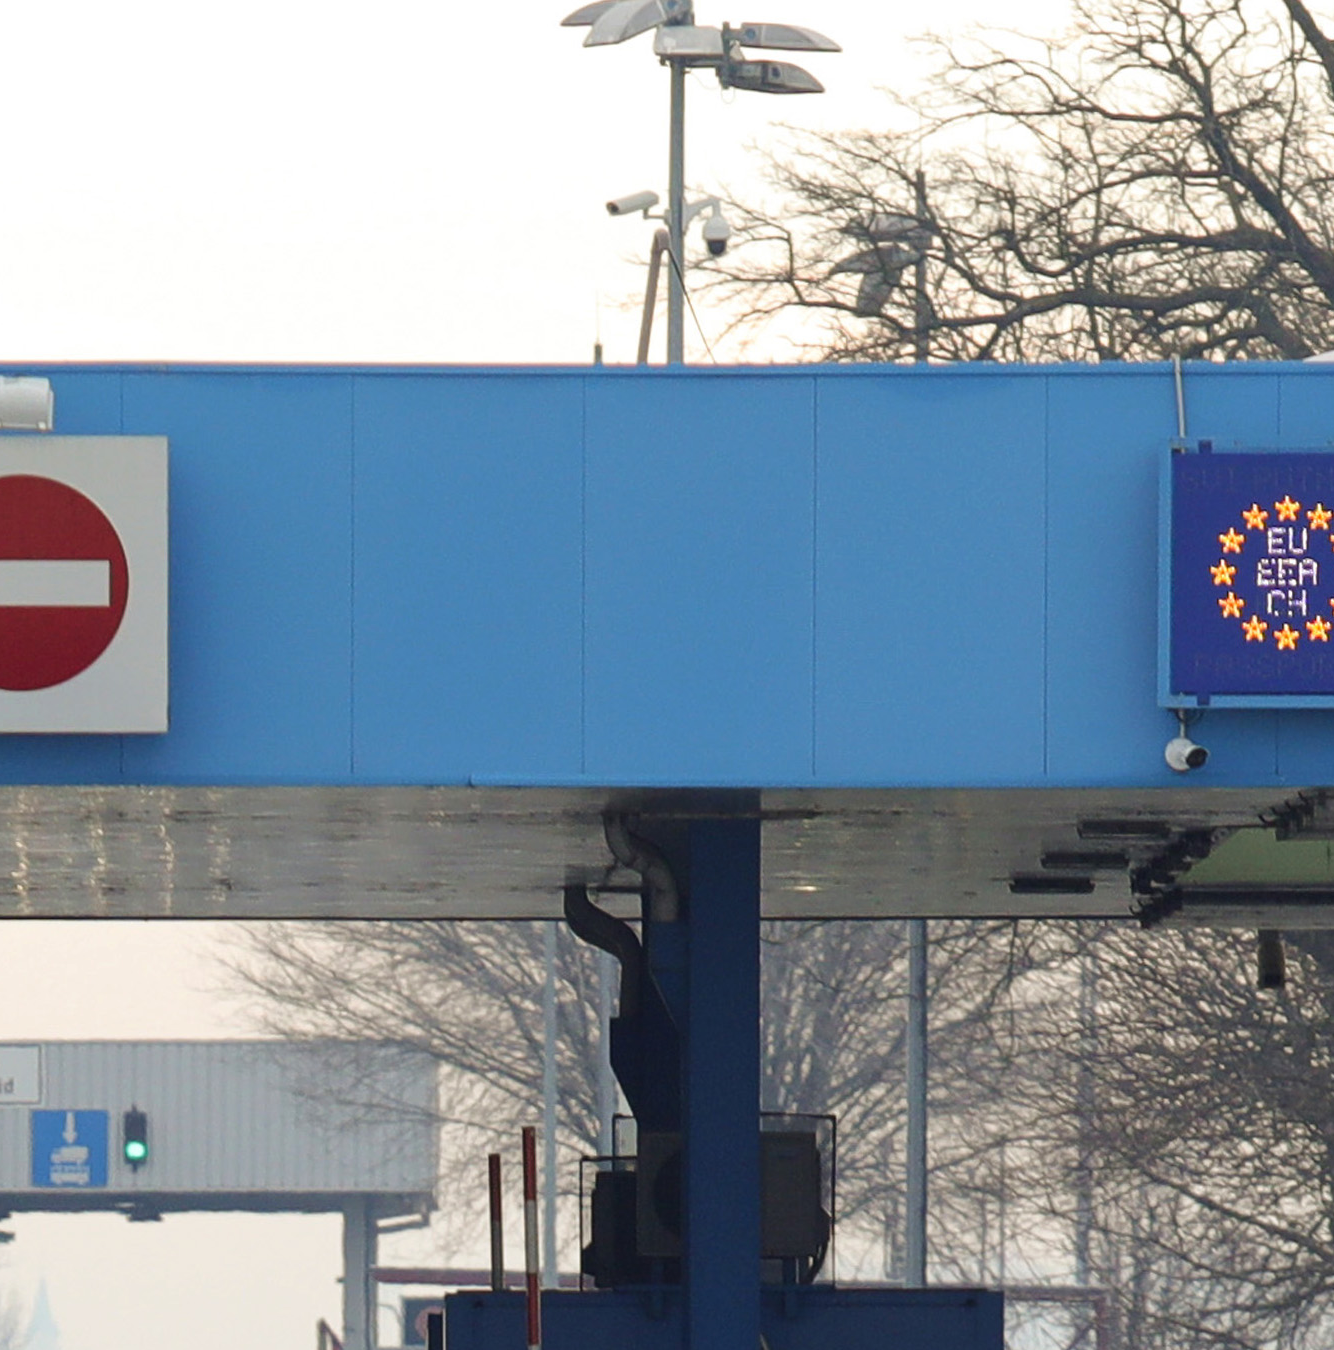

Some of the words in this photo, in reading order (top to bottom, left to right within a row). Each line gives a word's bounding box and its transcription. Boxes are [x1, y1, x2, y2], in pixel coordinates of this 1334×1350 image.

[1267, 526, 1308, 554] EU
[1256, 557, 1319, 587] EEA
[1267, 589, 1307, 616] CH
